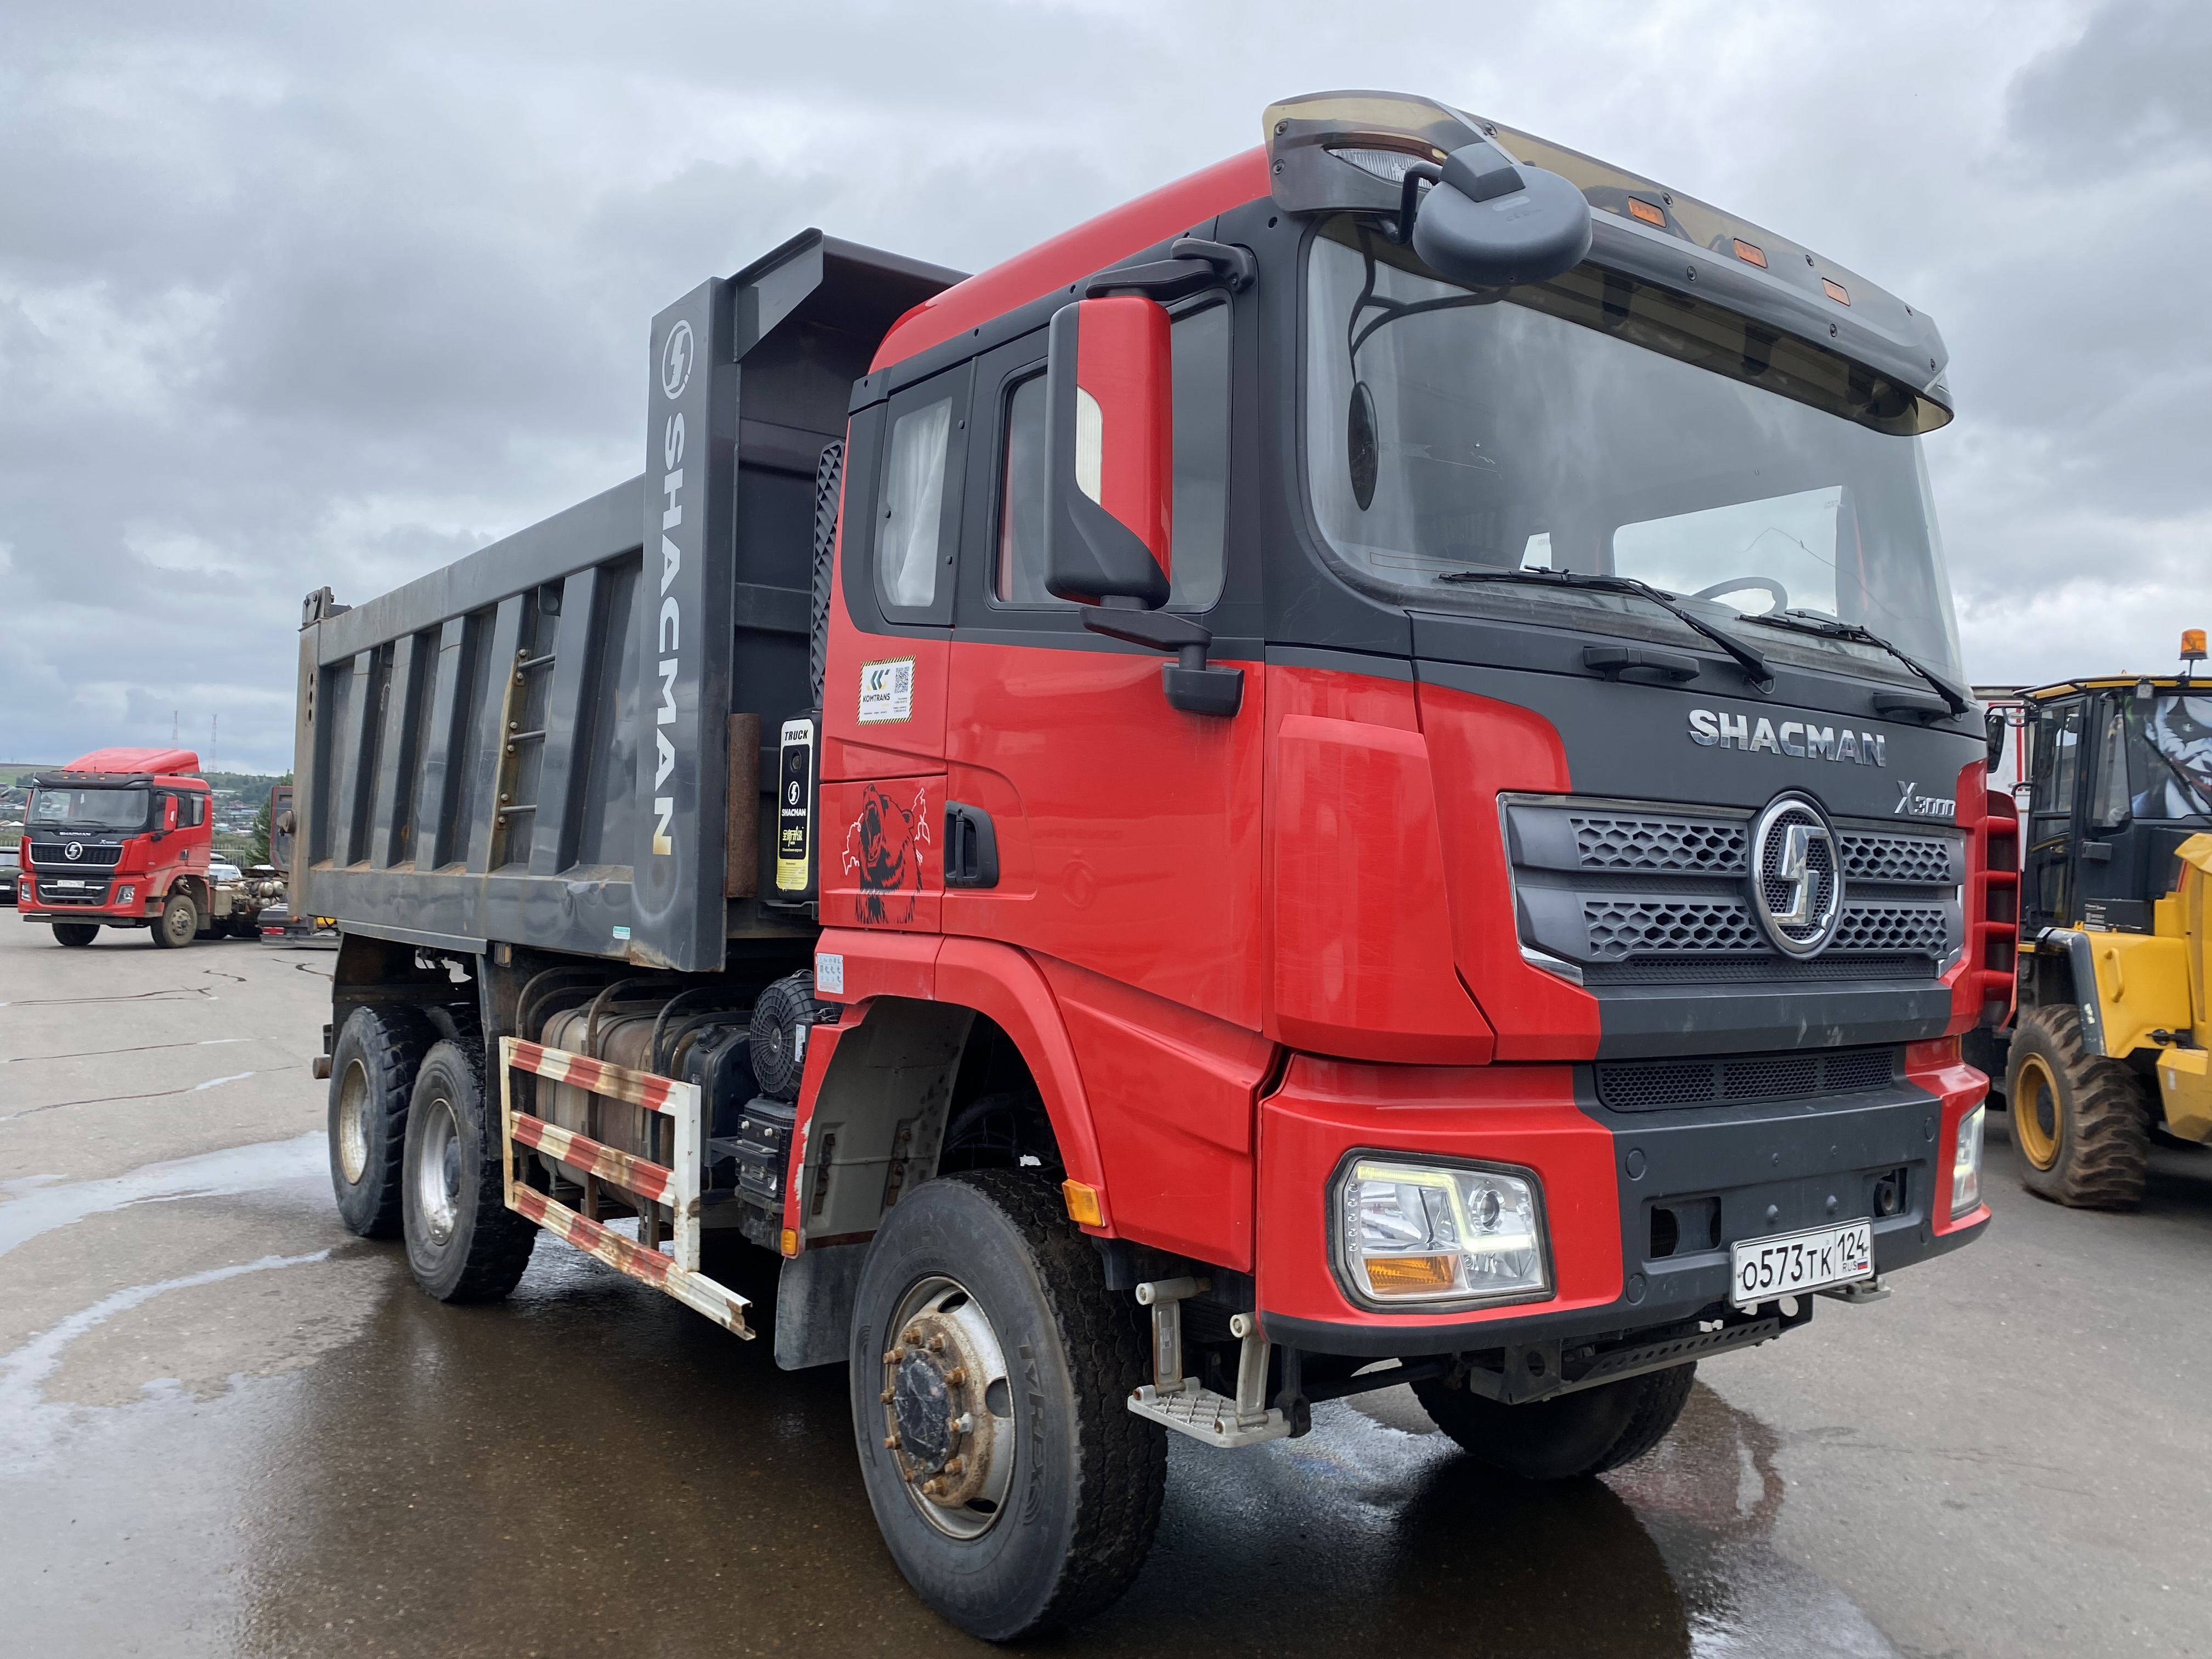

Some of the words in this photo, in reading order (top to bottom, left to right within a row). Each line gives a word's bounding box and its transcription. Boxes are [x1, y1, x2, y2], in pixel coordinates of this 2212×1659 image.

[653, 413, 686, 856] SHACMAN
[862, 693, 890, 703] KOMTRANS
[785, 729, 808, 741] TRUCK
[1688, 709, 1886, 767] SHACMAN
[1894, 781, 1956, 818] X3000
[781, 808, 806, 816] SHACMAN
[1837, 1229, 1865, 1261] 124
[1842, 1261, 1858, 1273] RUS
